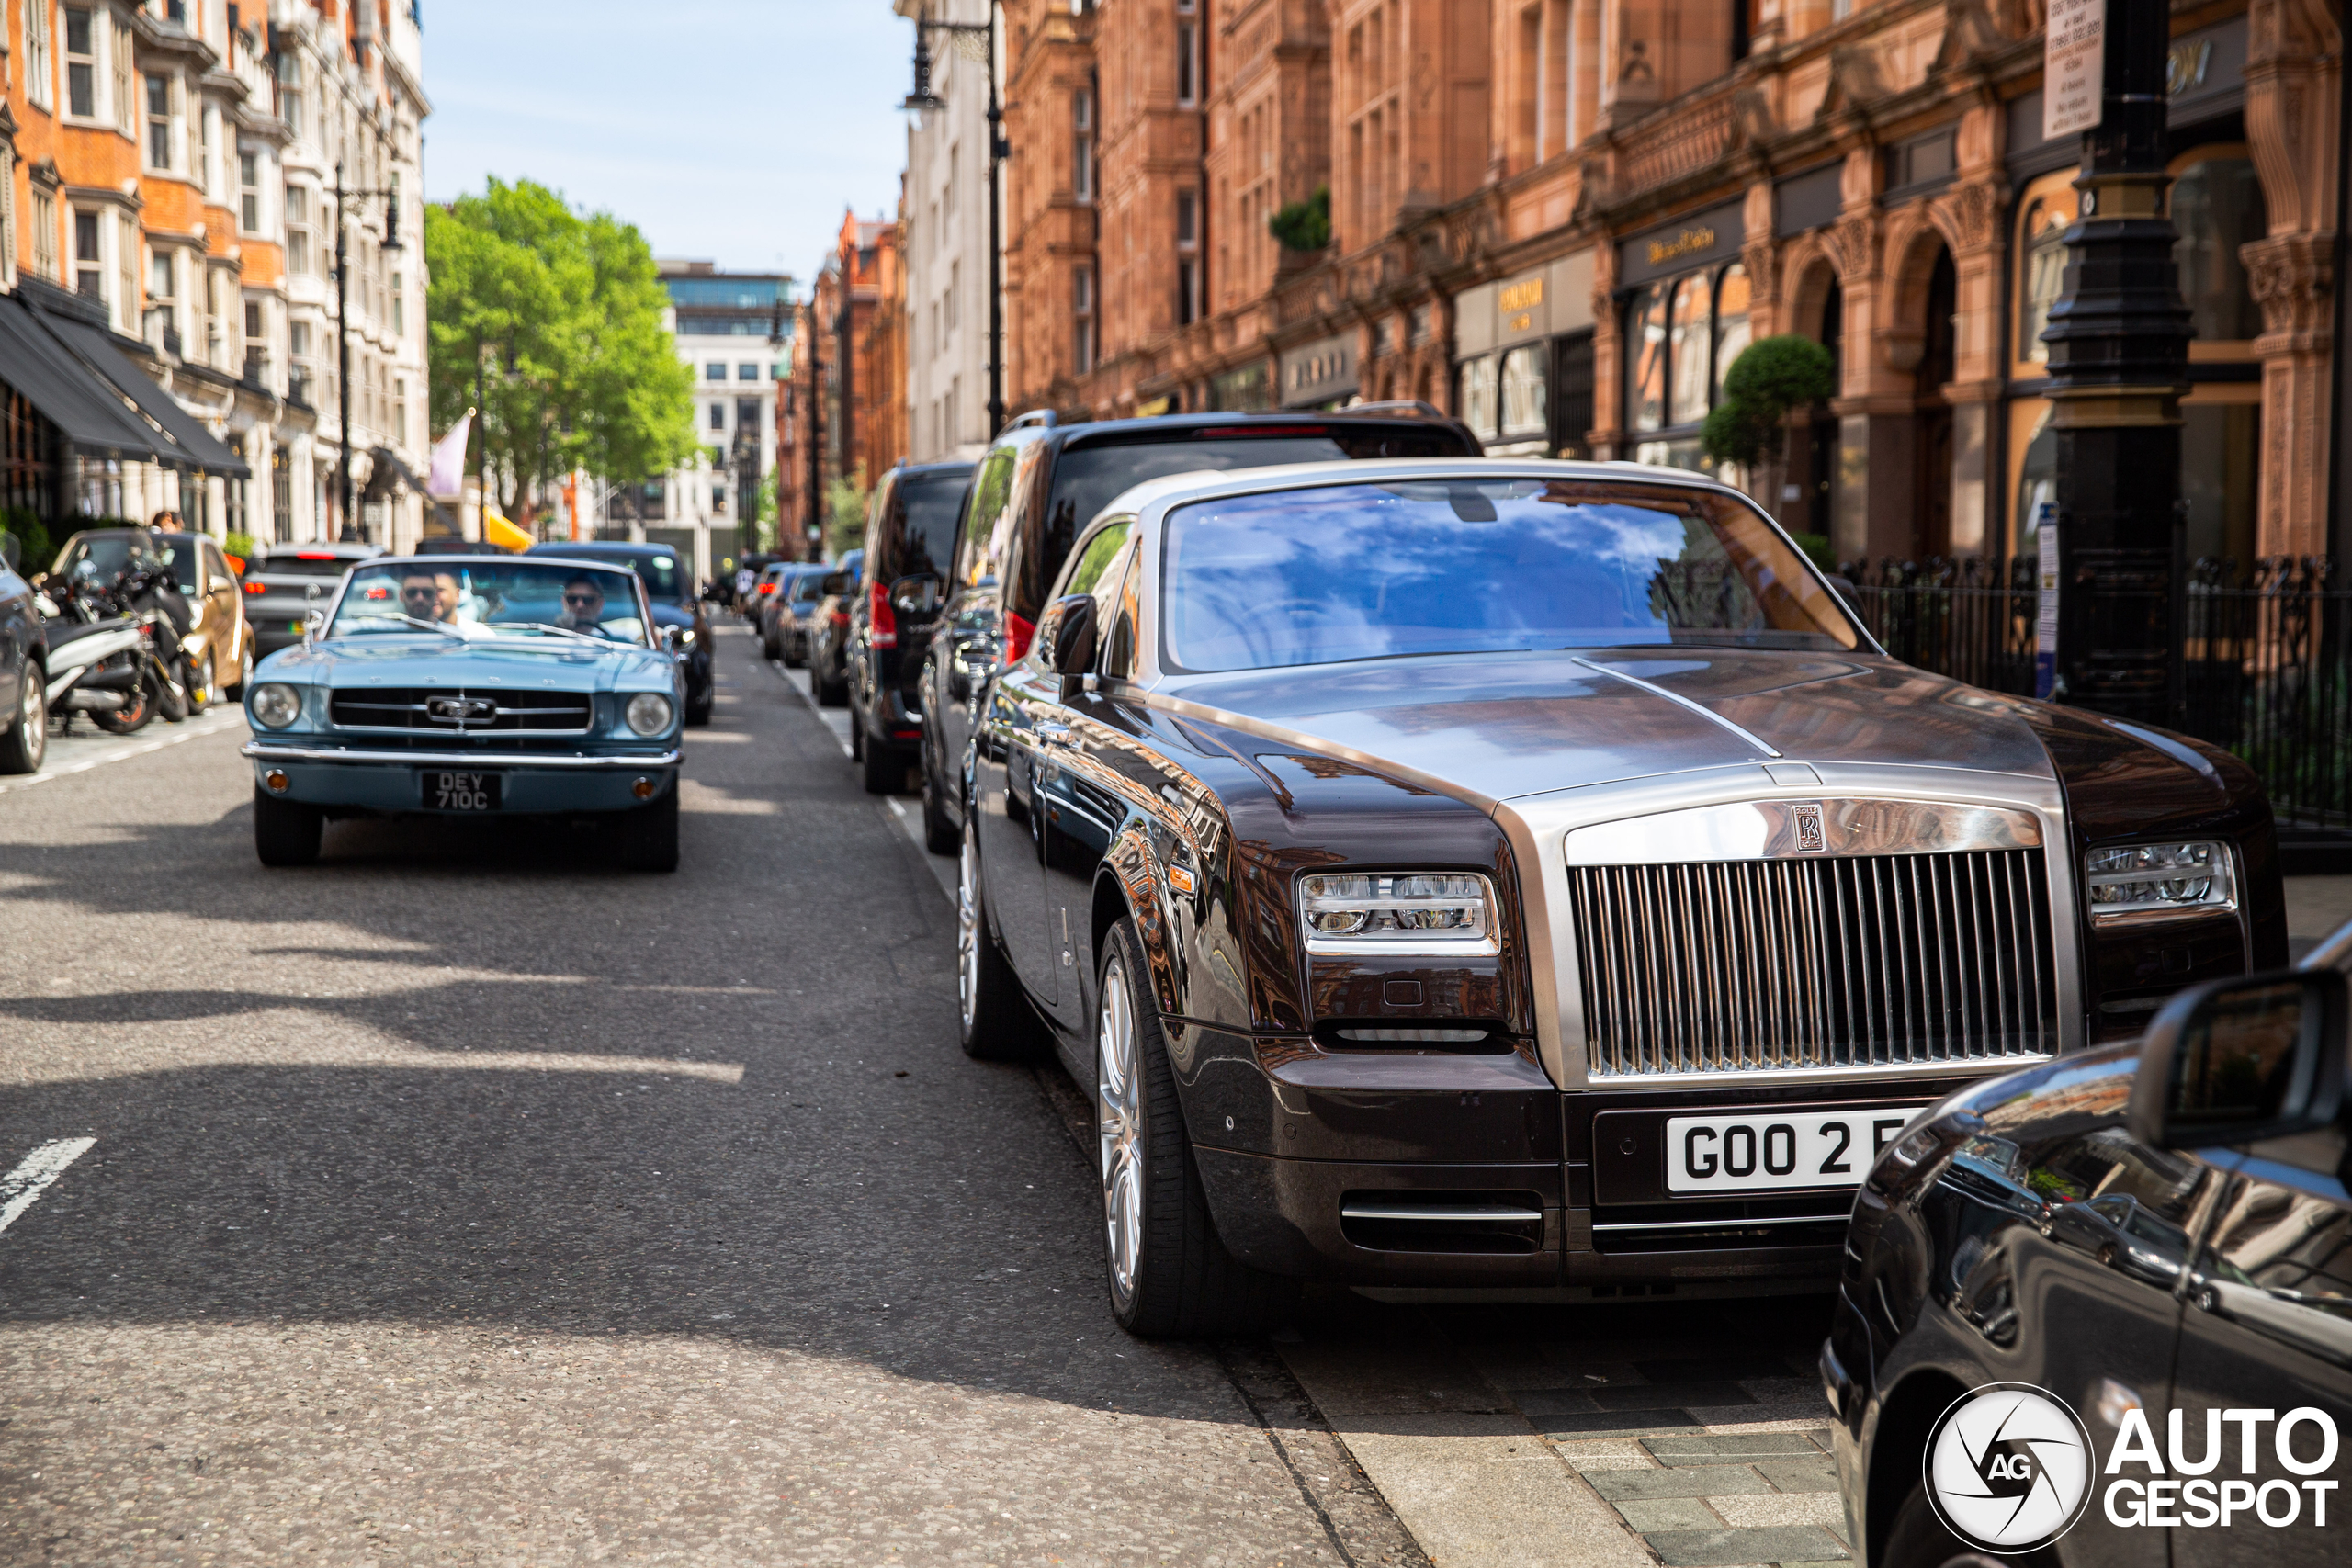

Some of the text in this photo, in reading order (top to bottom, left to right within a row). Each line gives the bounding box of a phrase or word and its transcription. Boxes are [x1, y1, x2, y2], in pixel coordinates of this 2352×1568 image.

[439, 773, 484, 791] DEY
[435, 791, 488, 810] 710C
[1819, 1122, 1851, 1174] 2
